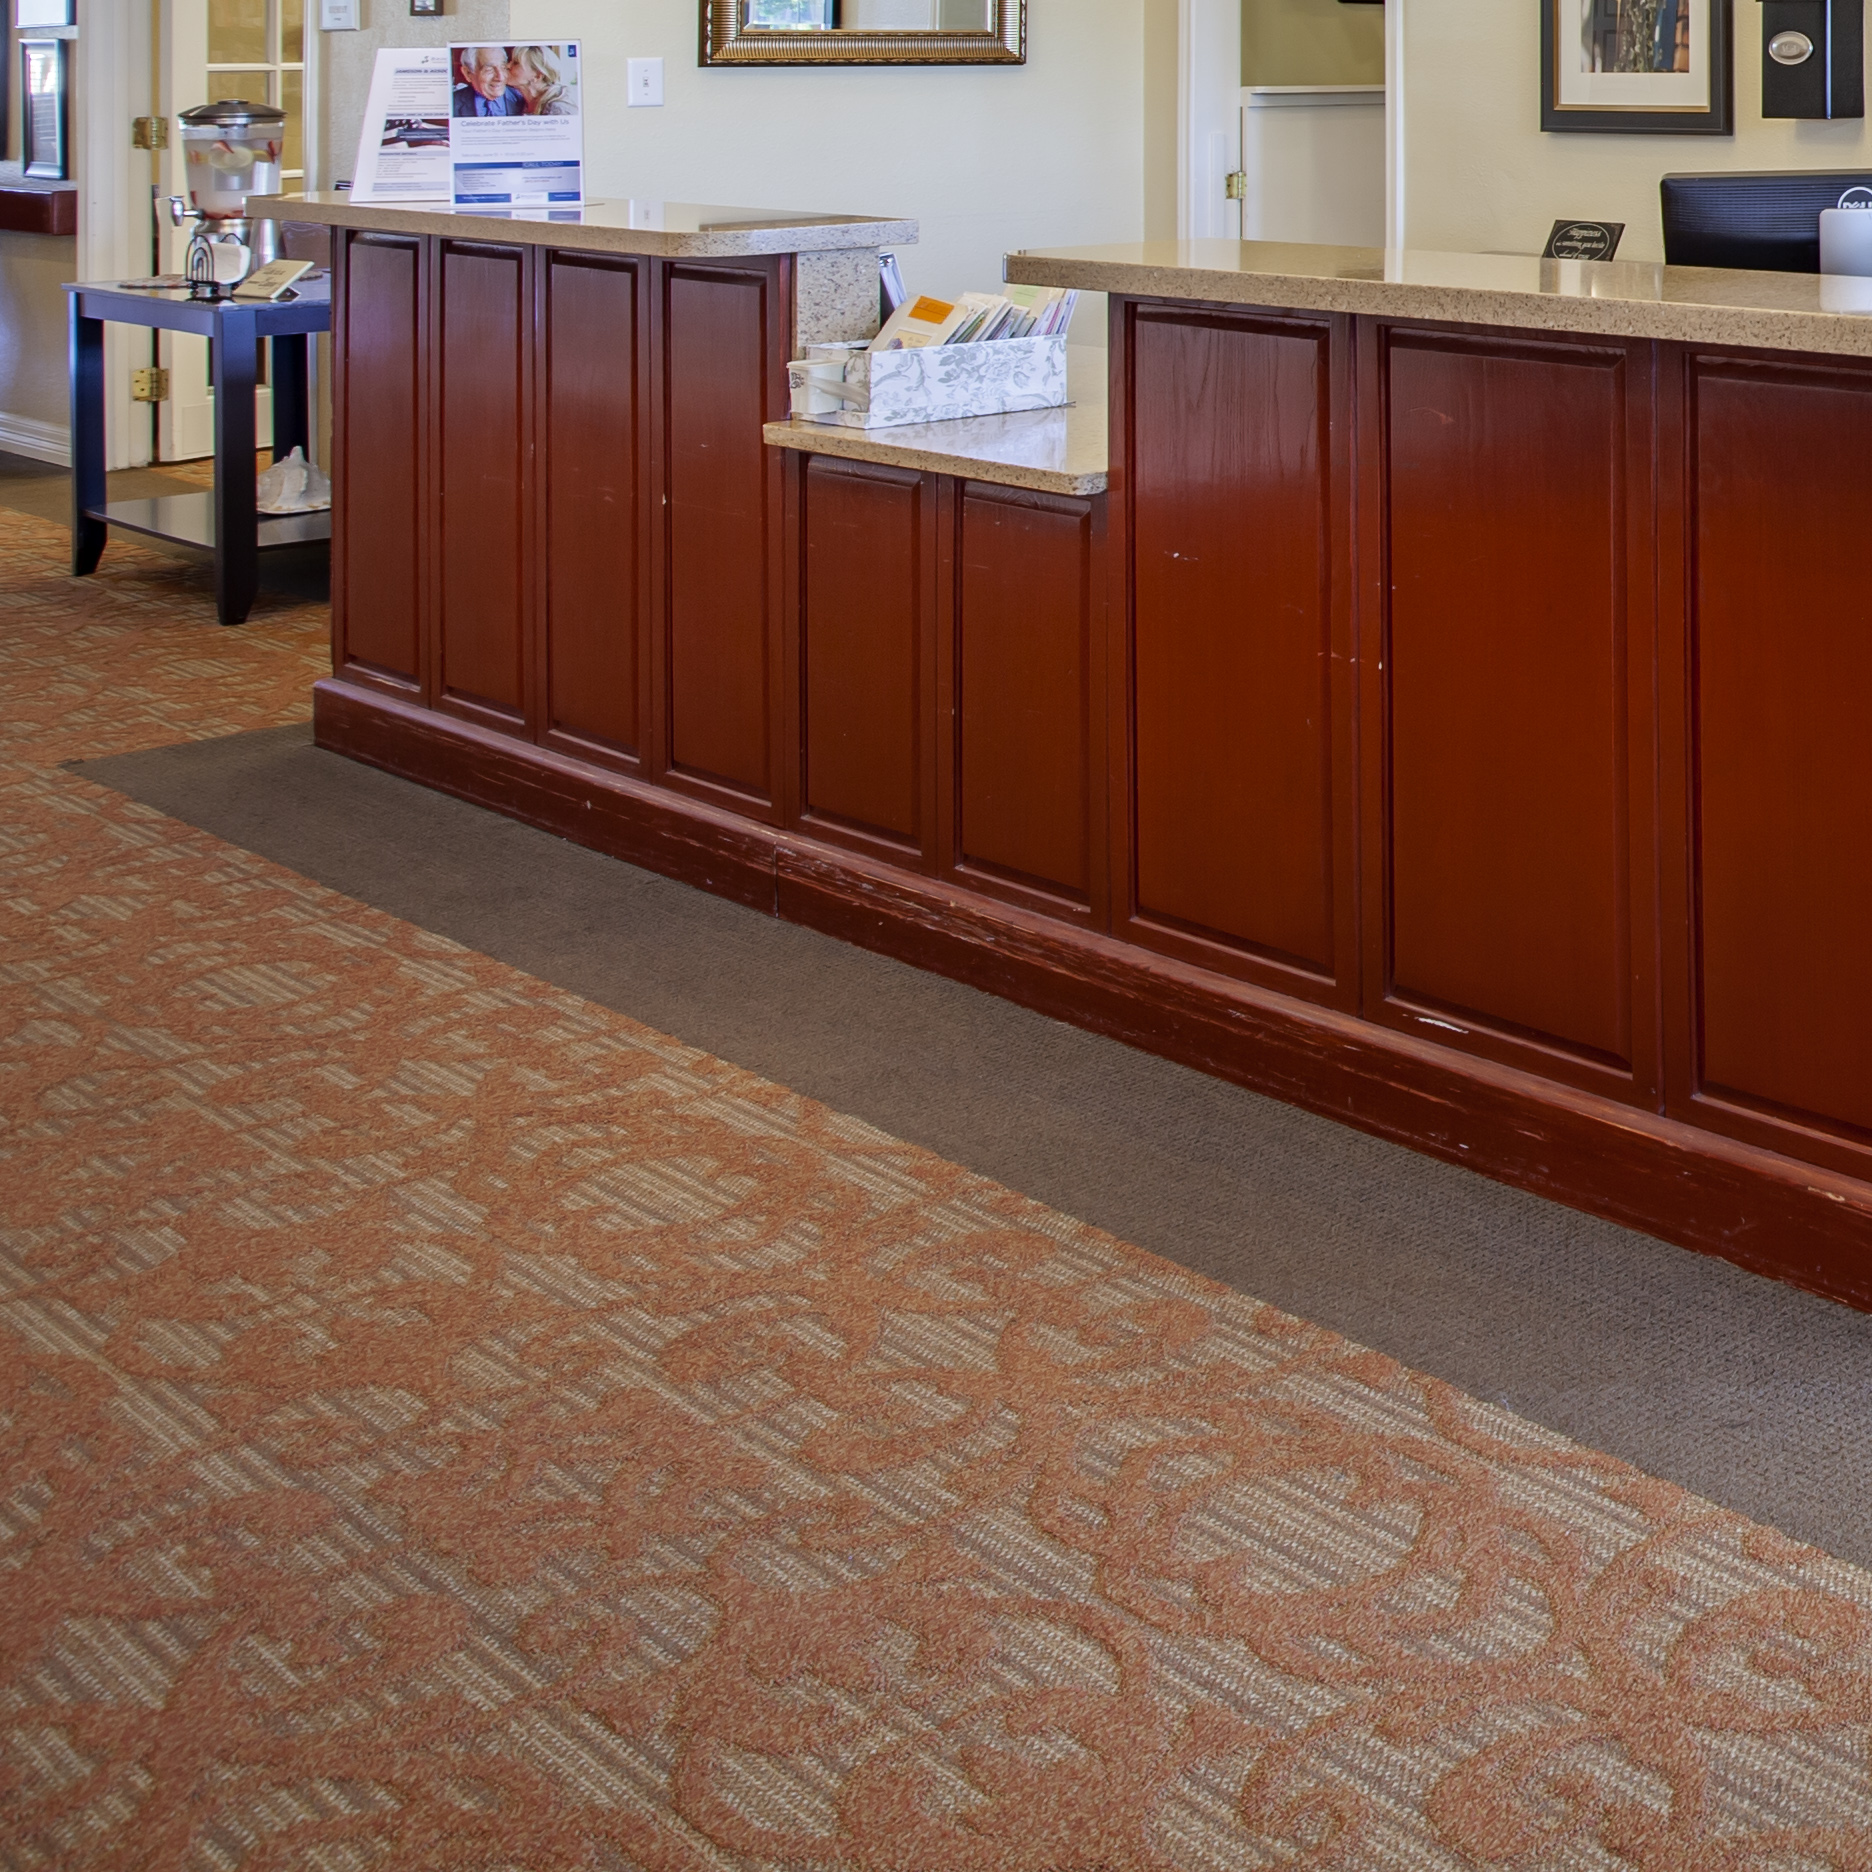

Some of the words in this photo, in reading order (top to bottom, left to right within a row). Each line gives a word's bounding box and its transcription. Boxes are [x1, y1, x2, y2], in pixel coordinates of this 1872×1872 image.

[461, 119, 495, 127] Celebrate
[497, 118, 526, 126] Father's
[527, 118, 541, 126] Day
